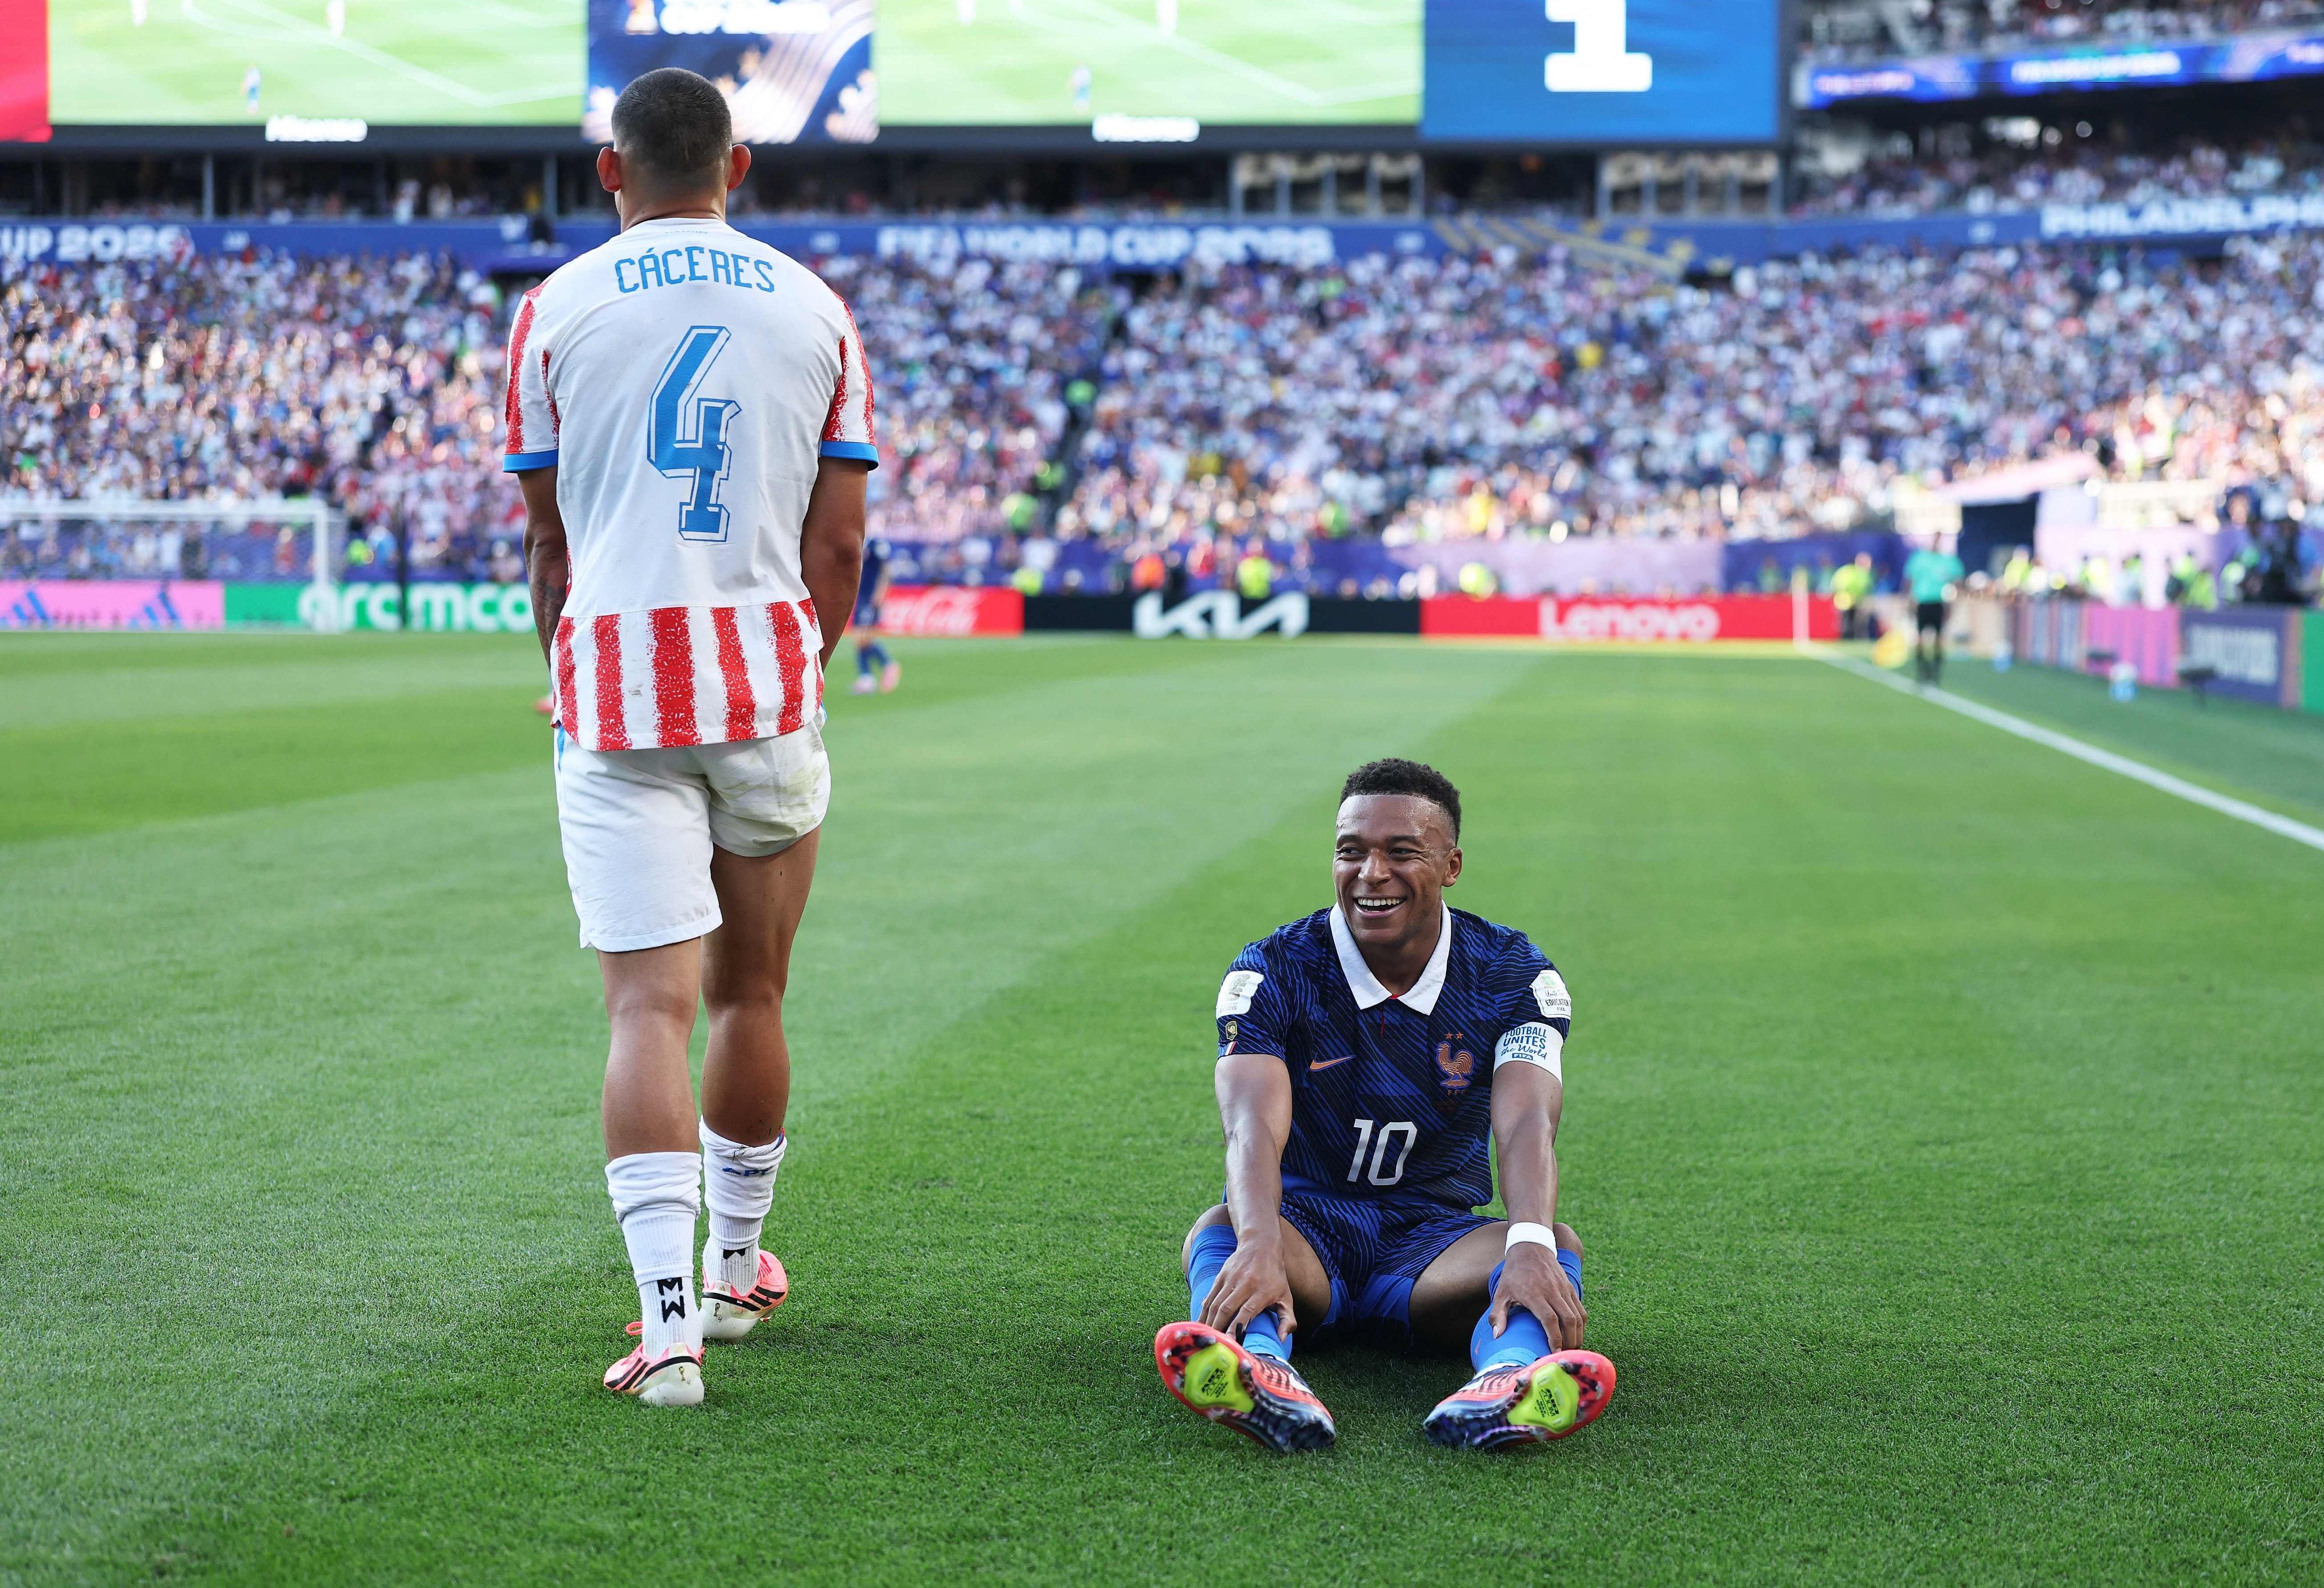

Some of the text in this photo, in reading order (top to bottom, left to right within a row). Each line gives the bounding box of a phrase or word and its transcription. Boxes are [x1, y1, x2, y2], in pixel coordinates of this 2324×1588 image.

[1544, 0, 1652, 92] 1
[2040, 194, 2324, 239] PHILADELPHI
[876, 225, 960, 263] FIFA
[962, 225, 1106, 264] WORLD
[1109, 225, 1193, 265] CUP
[615, 246, 774, 293] CÁCERES
[647, 325, 743, 542] 4
[1537, 597, 1722, 642] Lenovo
[1501, 1044, 1548, 1060] the World
[1503, 1036, 1546, 1050] UNITES
[1505, 1026, 1547, 1039] FOOTBALL
[1347, 1119, 1418, 1186] 10
[1541, 1389, 1556, 1416] ZOOM
[1546, 1388, 1559, 1414] AIR
